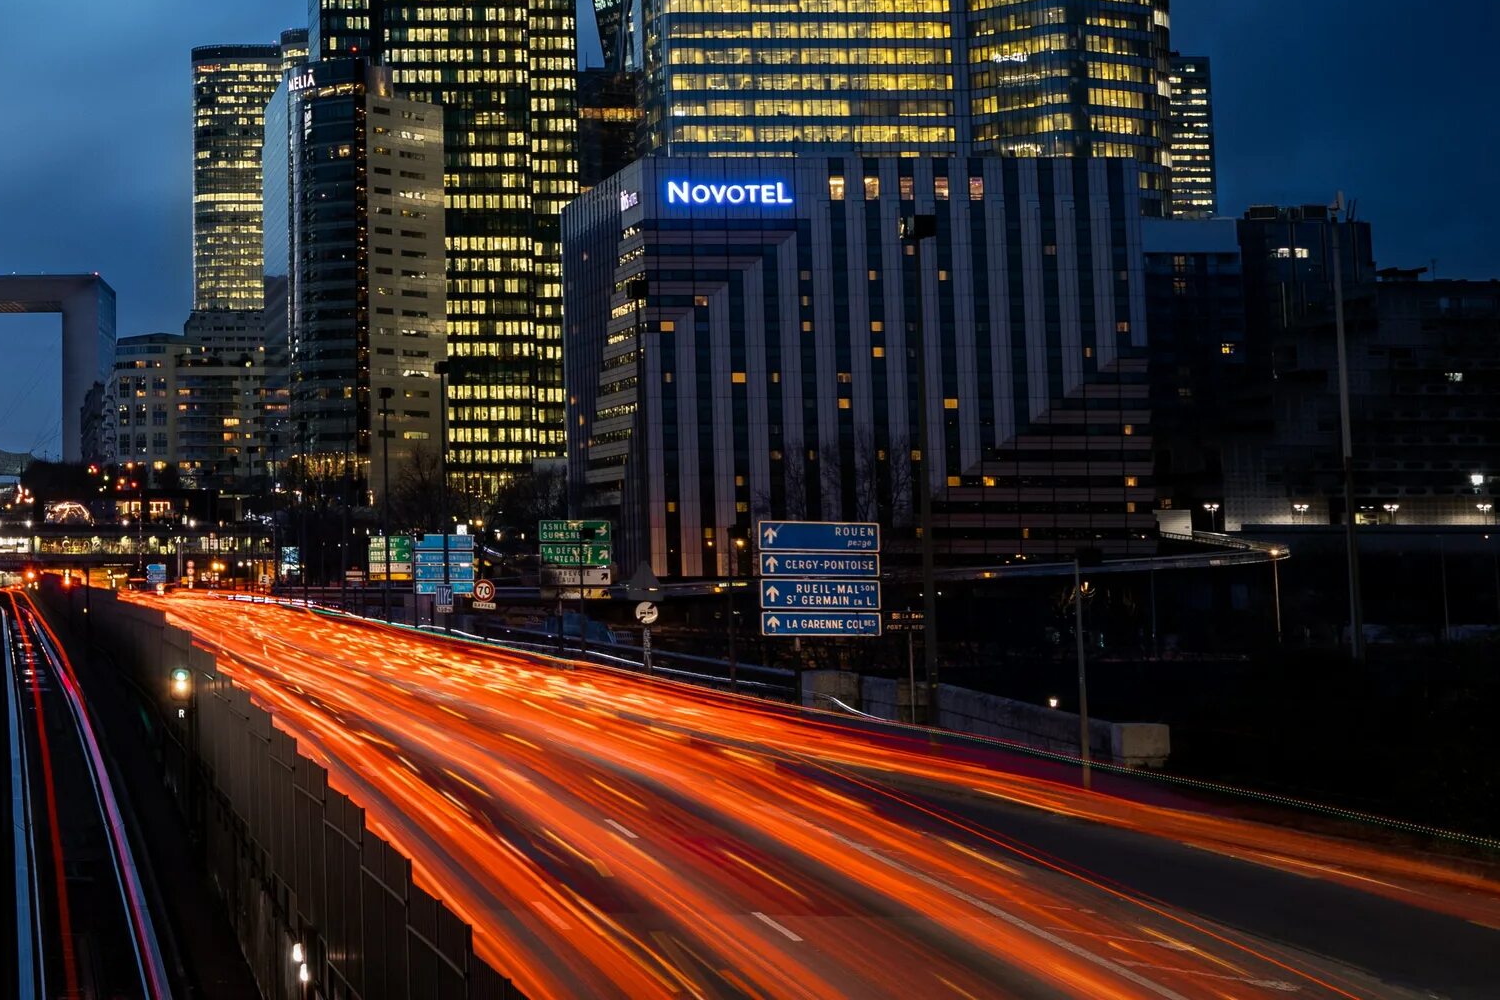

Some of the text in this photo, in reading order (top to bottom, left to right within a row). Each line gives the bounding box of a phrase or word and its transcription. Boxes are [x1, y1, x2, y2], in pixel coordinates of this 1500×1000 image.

[667, 181, 793, 204] NOVOTEL
[835, 527, 874, 537] ROUEN
[785, 559, 875, 570] CERGY-PONTOISE
[478, 586, 490, 595] 70
[801, 595, 849, 606] GERMAIN
[786, 619, 798, 629] LA
[801, 619, 844, 629] GARENNE
[178, 708, 185, 719] R
